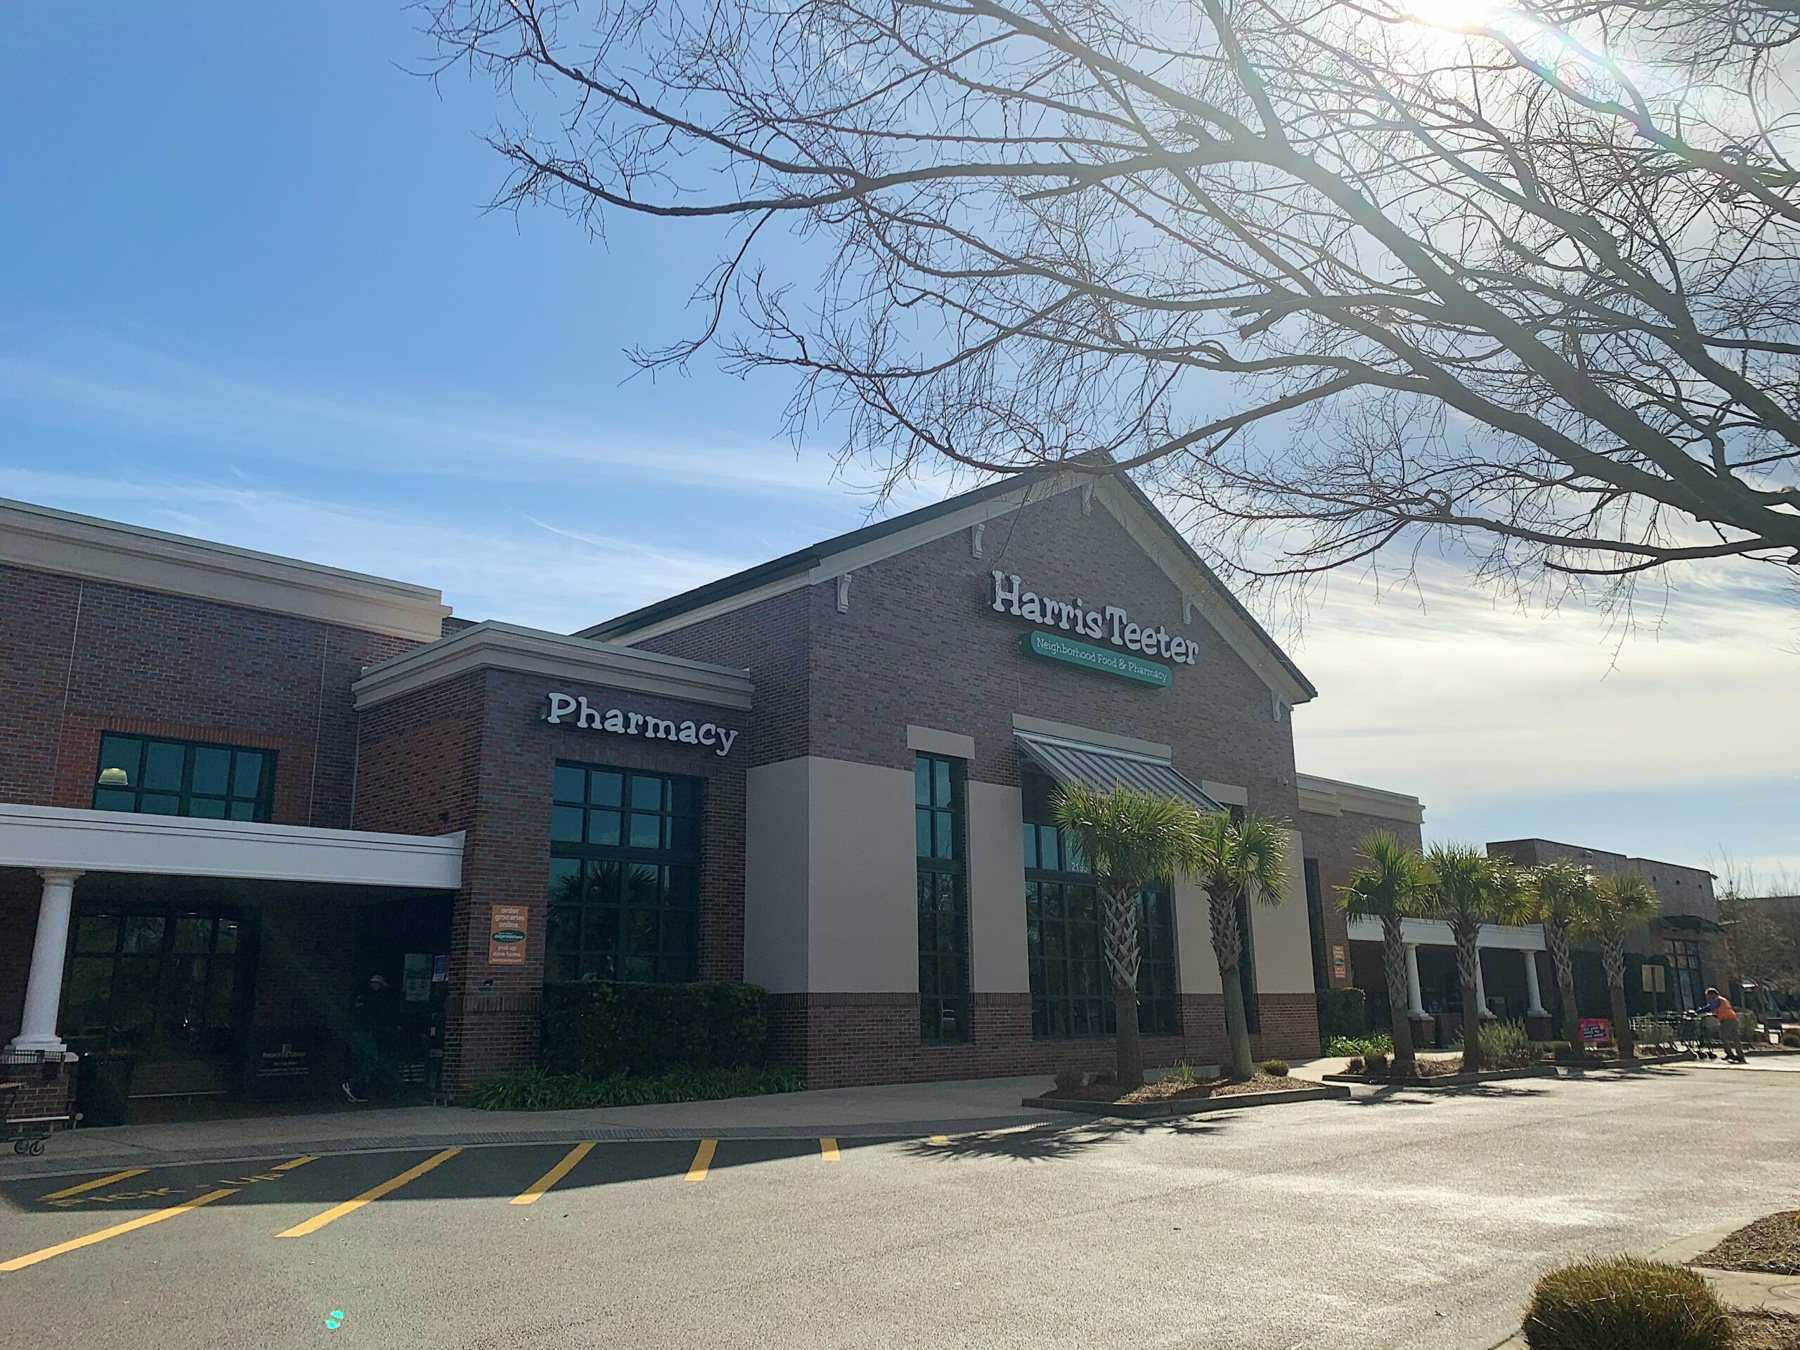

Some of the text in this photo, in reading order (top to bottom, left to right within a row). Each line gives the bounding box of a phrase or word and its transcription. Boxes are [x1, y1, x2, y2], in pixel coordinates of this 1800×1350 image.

[1036, 637, 1168, 683] Neighborhood Food & Pharmacy
[547, 692, 739, 757] Pharmacy
